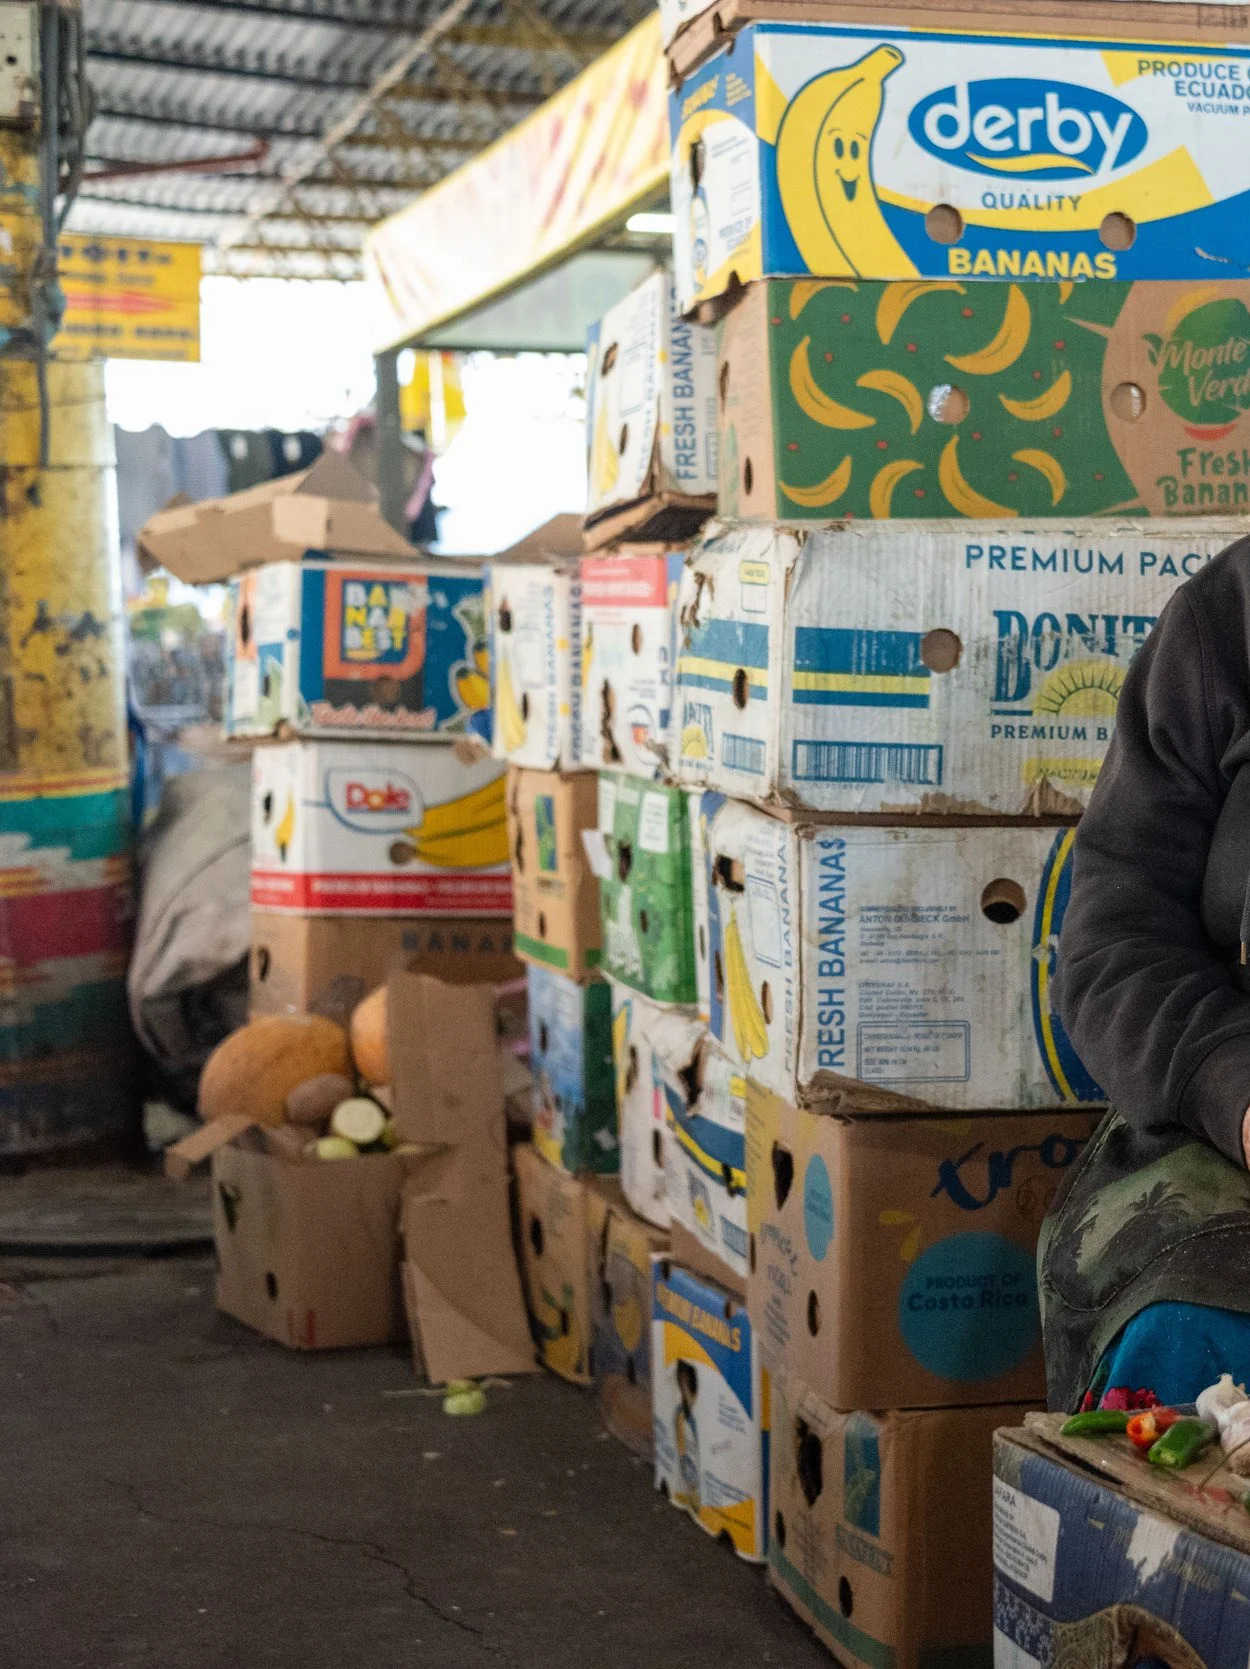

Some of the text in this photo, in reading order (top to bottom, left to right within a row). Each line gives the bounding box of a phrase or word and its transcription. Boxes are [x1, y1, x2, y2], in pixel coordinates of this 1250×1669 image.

[1137, 58, 1240, 82] PRODUCE
[1187, 102, 1239, 116] VACUUM
[923, 82, 1132, 173] derby
[981, 192, 1082, 213] QUALITY
[948, 248, 1117, 280] BANANAS
[1150, 334, 1247, 377] Monte
[670, 288, 698, 481] FRESH BANAN
[965, 544, 1213, 577] PREMIUM PAC
[990, 609, 1160, 703] BONIT
[991, 724, 1088, 741] PREMIUM
[859, 915, 892, 924] ANTON
[942, 914, 970, 923] GmbH
[818, 837, 846, 1067] RESH BANANAS
[926, 1272, 1024, 1289] PRODUCT OF
[907, 1290, 1028, 1311] Costa Rica
